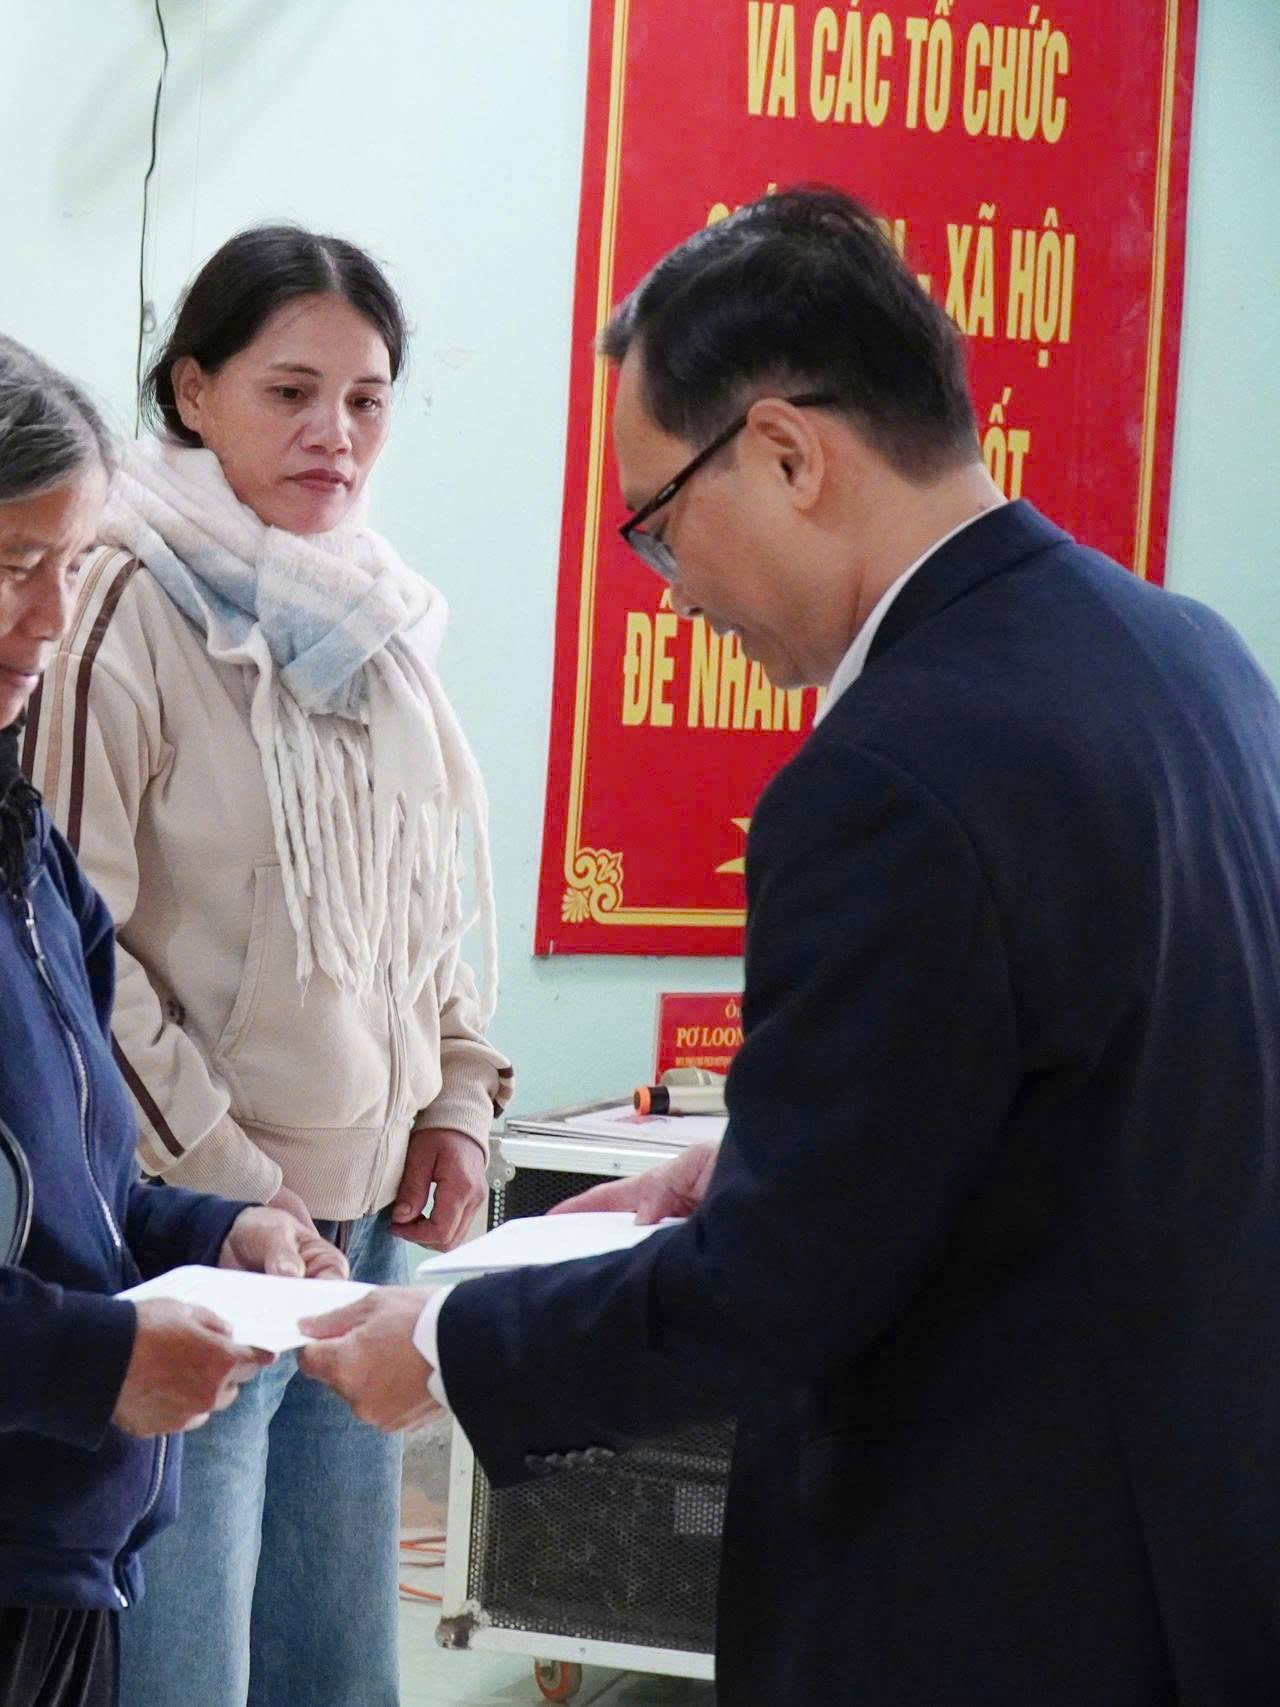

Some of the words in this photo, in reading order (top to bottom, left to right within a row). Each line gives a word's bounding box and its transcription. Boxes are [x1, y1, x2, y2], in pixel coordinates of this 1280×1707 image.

[810, 0, 893, 128] CÁC
[963, 5, 1069, 143] CHỨC
[945, 202, 995, 337] XÃ
[1006, 207, 1076, 369] HỘI
[982, 387, 1031, 501] ỐT
